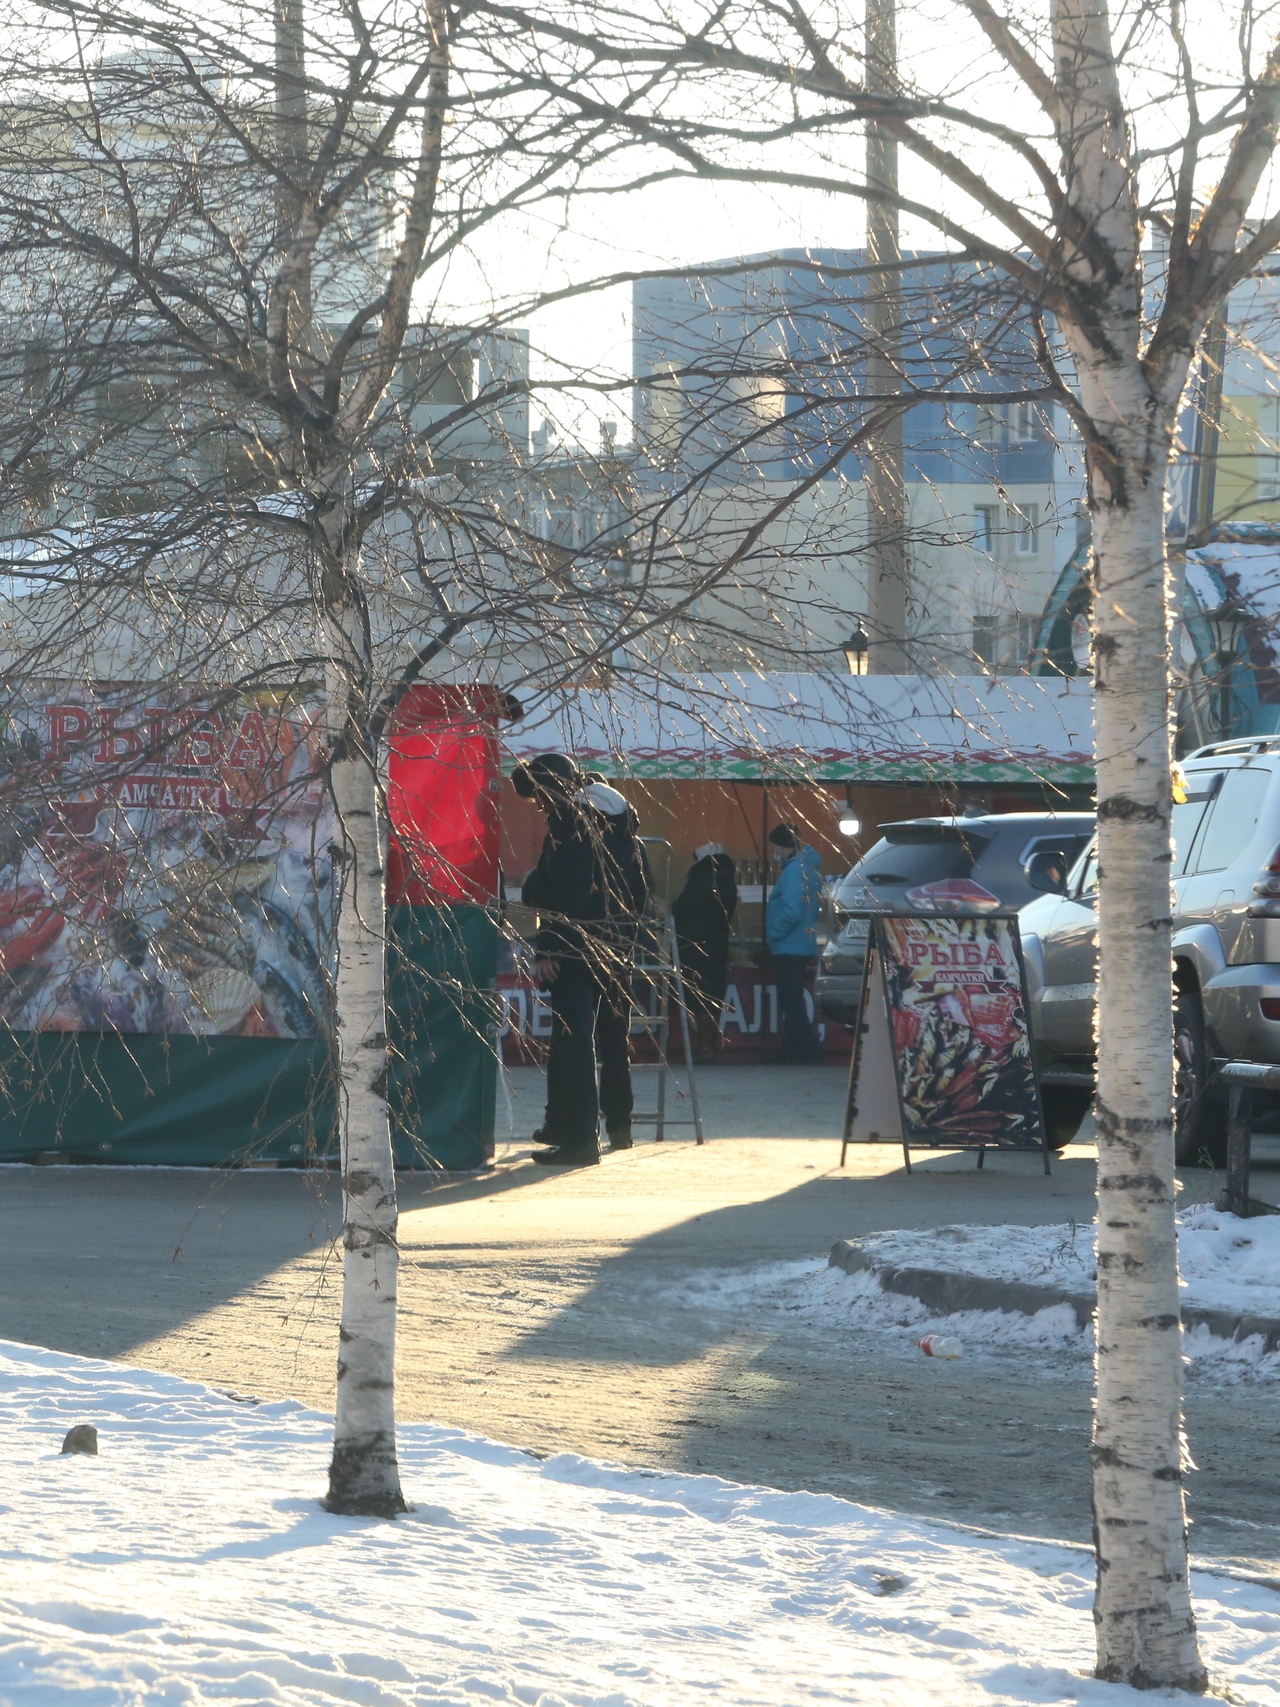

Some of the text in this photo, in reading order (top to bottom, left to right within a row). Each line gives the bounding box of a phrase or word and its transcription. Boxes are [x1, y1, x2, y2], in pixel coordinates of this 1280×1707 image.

[44, 705, 282, 771] РЫБА
[909, 943, 1006, 966] РЫБА
[935, 973, 985, 984] КАМЧАТКИ
